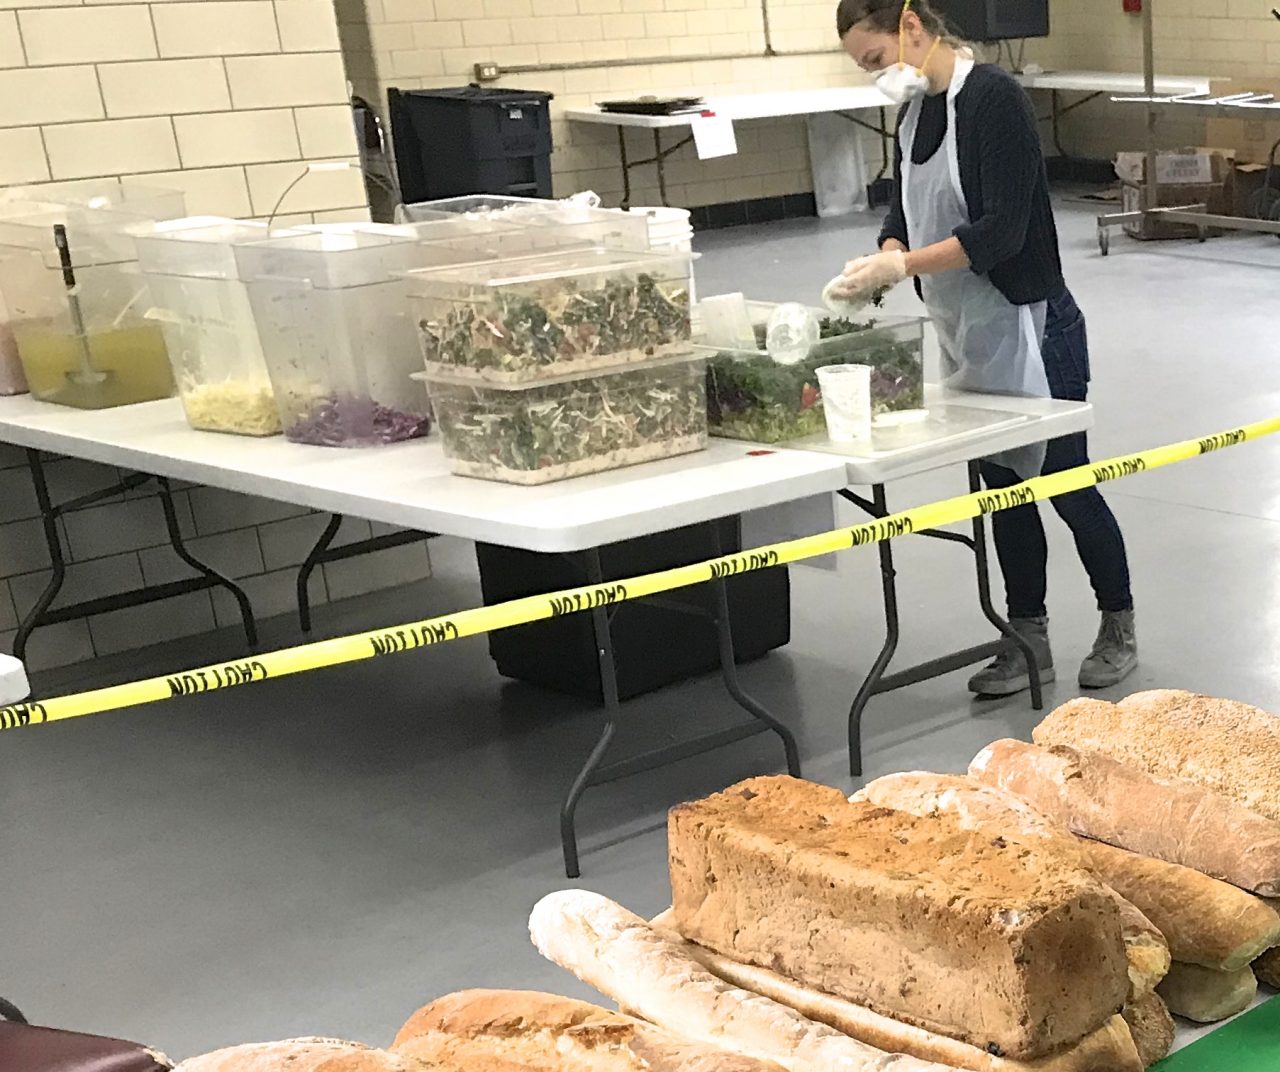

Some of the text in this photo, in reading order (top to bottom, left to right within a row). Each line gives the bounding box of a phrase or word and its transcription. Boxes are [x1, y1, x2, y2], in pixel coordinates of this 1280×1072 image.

[1094, 457, 1146, 484] CAUTION
[978, 486, 1035, 515] CAUTION
[851, 517, 913, 547] CAUTION
[710, 550, 779, 577] CAUTION
[549, 584, 627, 618] CAUTION
[371, 620, 458, 657] CAUTION
[167, 661, 268, 697] CAUTION
